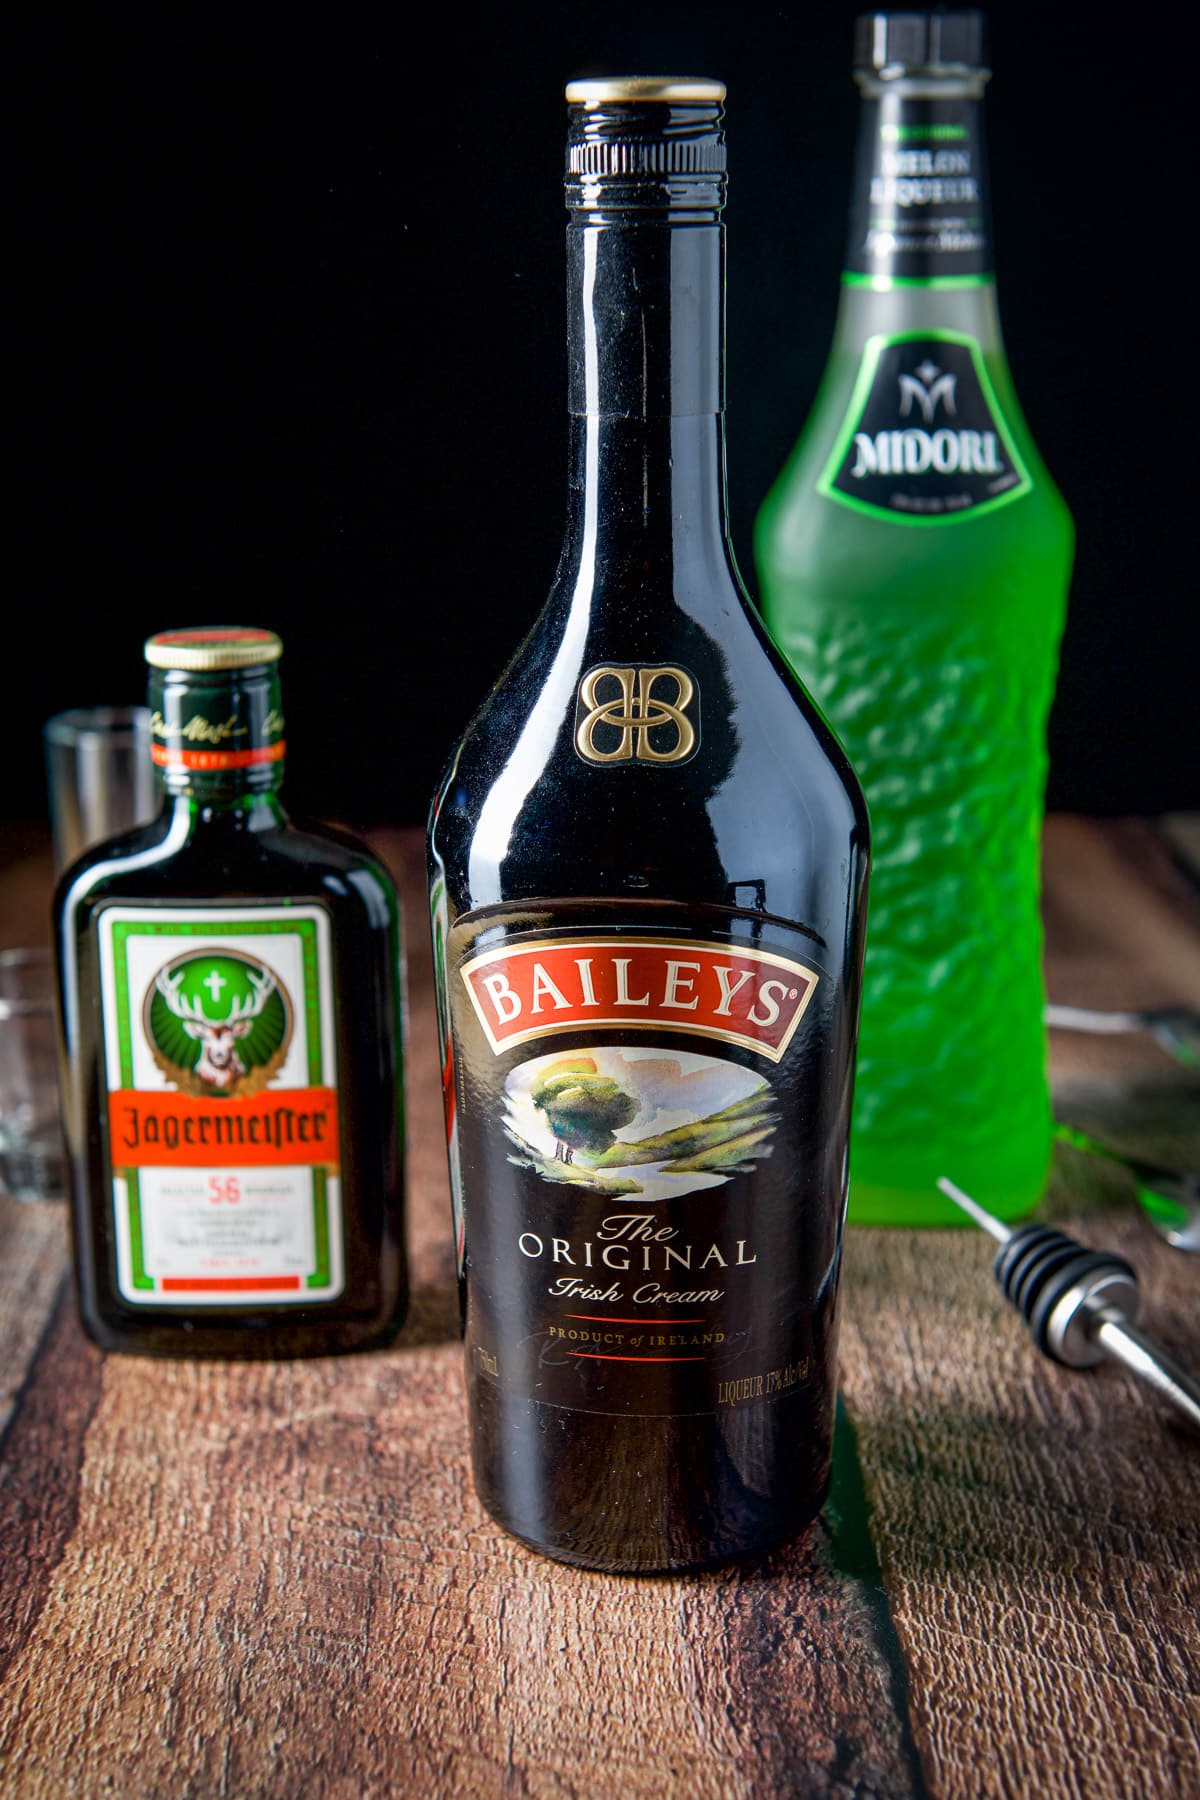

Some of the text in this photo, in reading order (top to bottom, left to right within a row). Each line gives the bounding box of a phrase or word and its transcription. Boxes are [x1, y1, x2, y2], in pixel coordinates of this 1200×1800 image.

[851, 428, 1004, 478] MIDORI
[483, 958, 789, 1027] BAILEYS
[208, 1176, 241, 1205] 56
[596, 1214, 679, 1242] The
[518, 1232, 757, 1271] ORIGINAL
[548, 1277, 725, 1304] Irish Cream
[549, 1326, 726, 1348] PRODUCT of IRELAND
[718, 1375, 763, 1407] LIQUEUR
